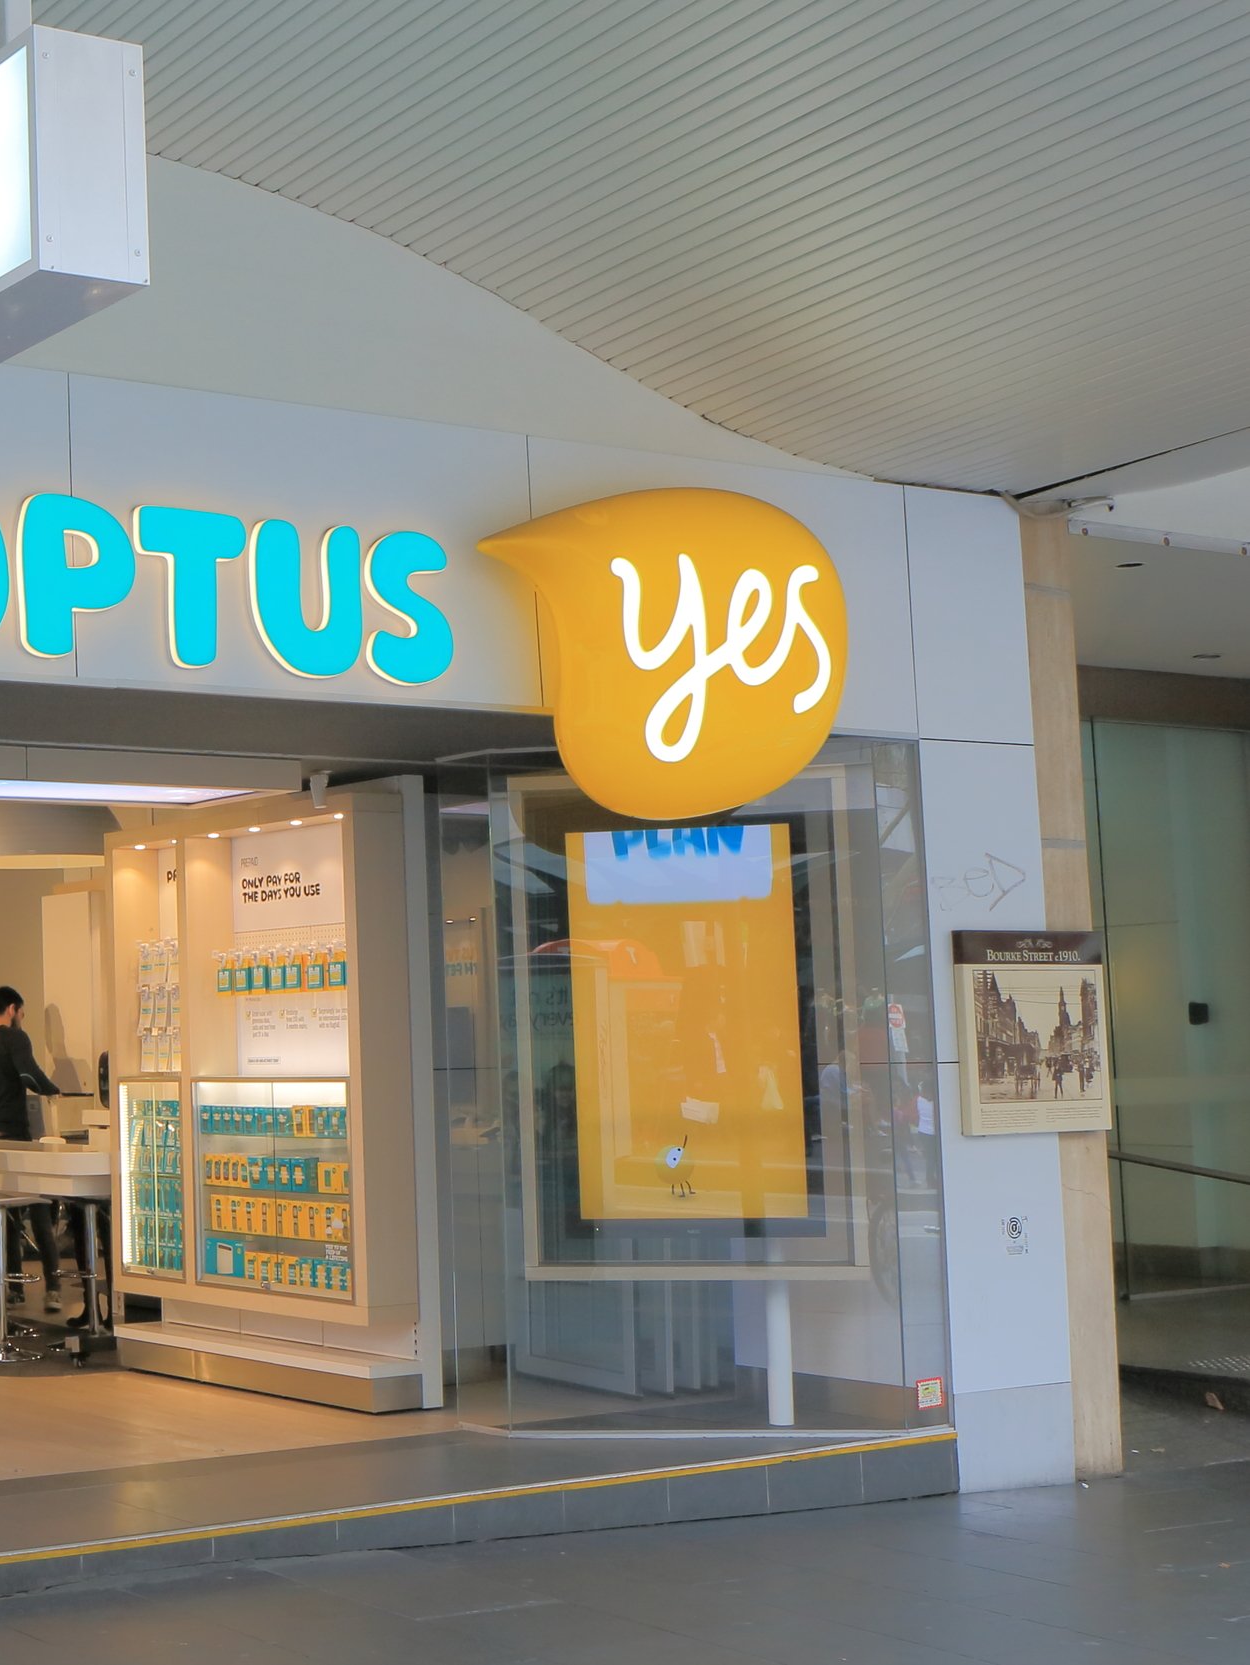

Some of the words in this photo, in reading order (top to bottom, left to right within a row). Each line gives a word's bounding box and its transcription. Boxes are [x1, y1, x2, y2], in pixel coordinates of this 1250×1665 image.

[610, 553, 832, 763] yes
[242, 876, 264, 889] ONLY
[266, 875, 282, 887] PAY
[284, 872, 301, 885] FOR
[243, 891, 258, 903] THE
[261, 889, 282, 902] DAYS
[284, 886, 301, 898] YOU
[304, 883, 320, 897] USE
[986, 949, 1021, 961] BOURKE
[1022, 949, 1054, 962] STREET
